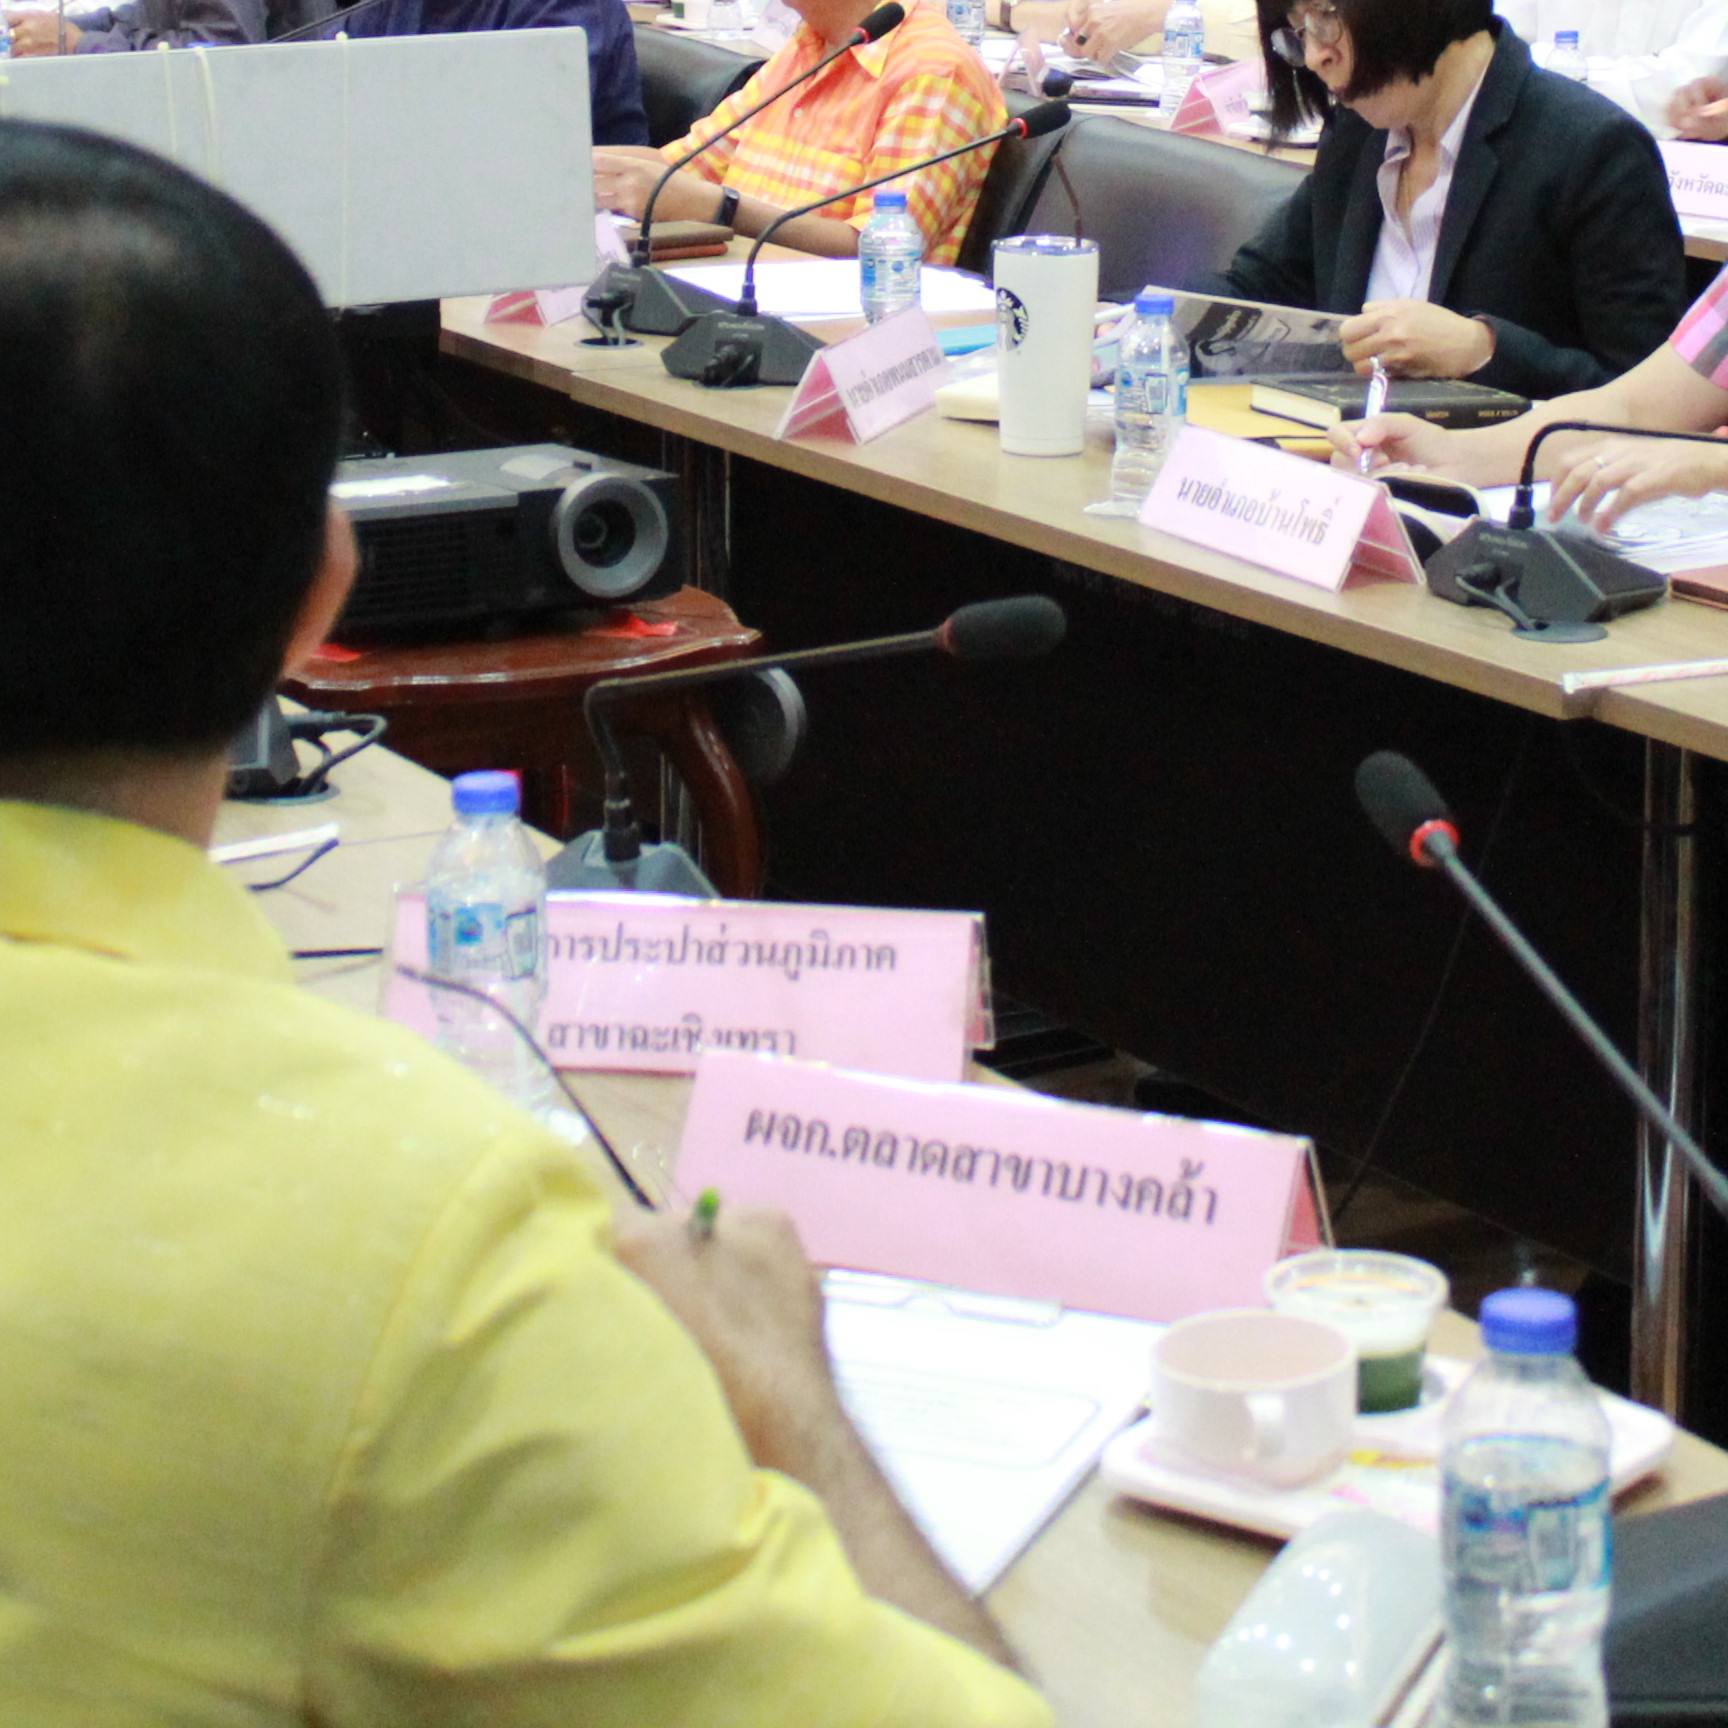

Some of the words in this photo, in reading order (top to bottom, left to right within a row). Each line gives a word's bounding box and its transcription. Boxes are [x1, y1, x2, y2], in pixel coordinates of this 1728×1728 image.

[1177, 475, 1342, 546] นายอำเภอบ้านโพธิ์
[743, 1105, 1219, 1227] ผจก.ตลาดสาขาบางคล้า
